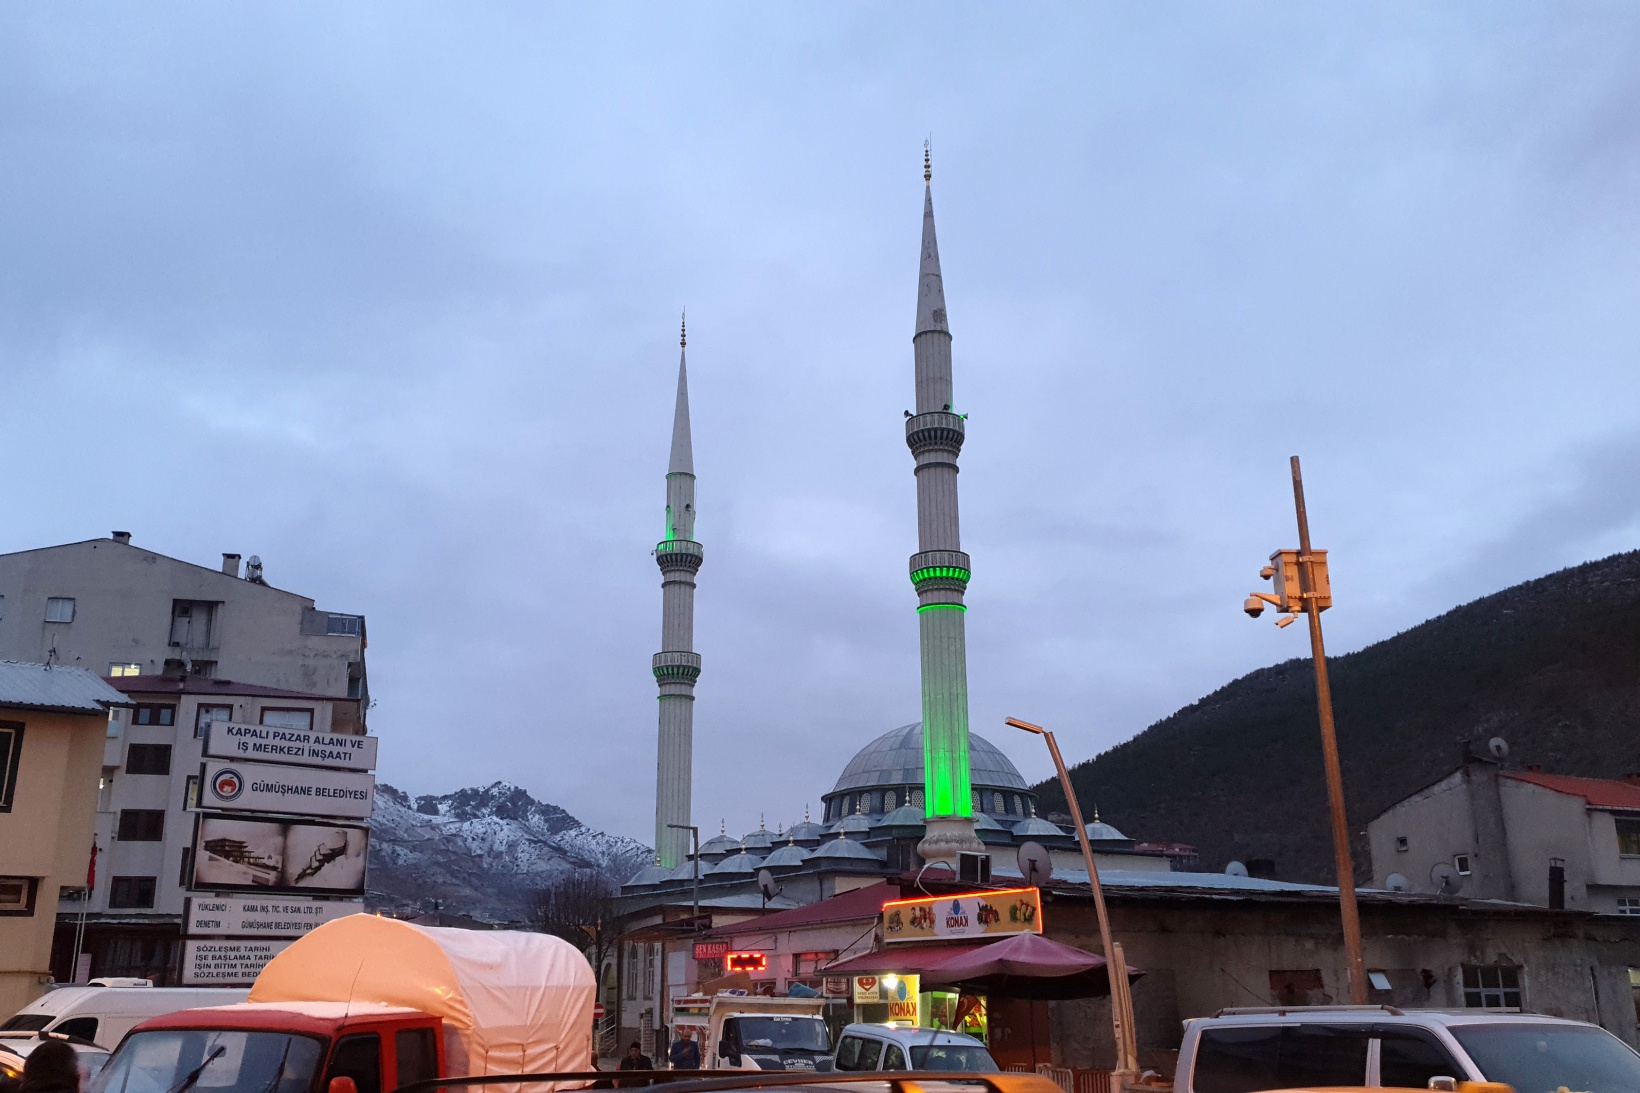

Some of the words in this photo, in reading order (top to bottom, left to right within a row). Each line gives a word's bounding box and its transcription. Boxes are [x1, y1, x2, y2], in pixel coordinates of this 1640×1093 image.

[227, 726, 269, 740] KAPALI
[272, 731, 310, 744] PAZAR
[313, 736, 347, 748] ALANI
[350, 739, 364, 749] VE
[237, 738, 249, 754] İŞ
[252, 742, 305, 757] MERKEZİ
[308, 746, 352, 761] İNŞAATI
[251, 780, 313, 797] GÜMÜŞHANE
[315, 786, 368, 800] BELEDİYESİ
[242, 905, 259, 913] KAMA
[282, 905, 290, 914] VE
[946, 915, 969, 929] KONAK
[196, 944, 241, 953] SÖZLEŞME
[244, 944, 270, 953] TARİHİ
[211, 954, 252, 962] BAŞLAMA
[193, 970, 239, 979] SÖZLEŞME
[889, 1001, 917, 1017] KONAK
